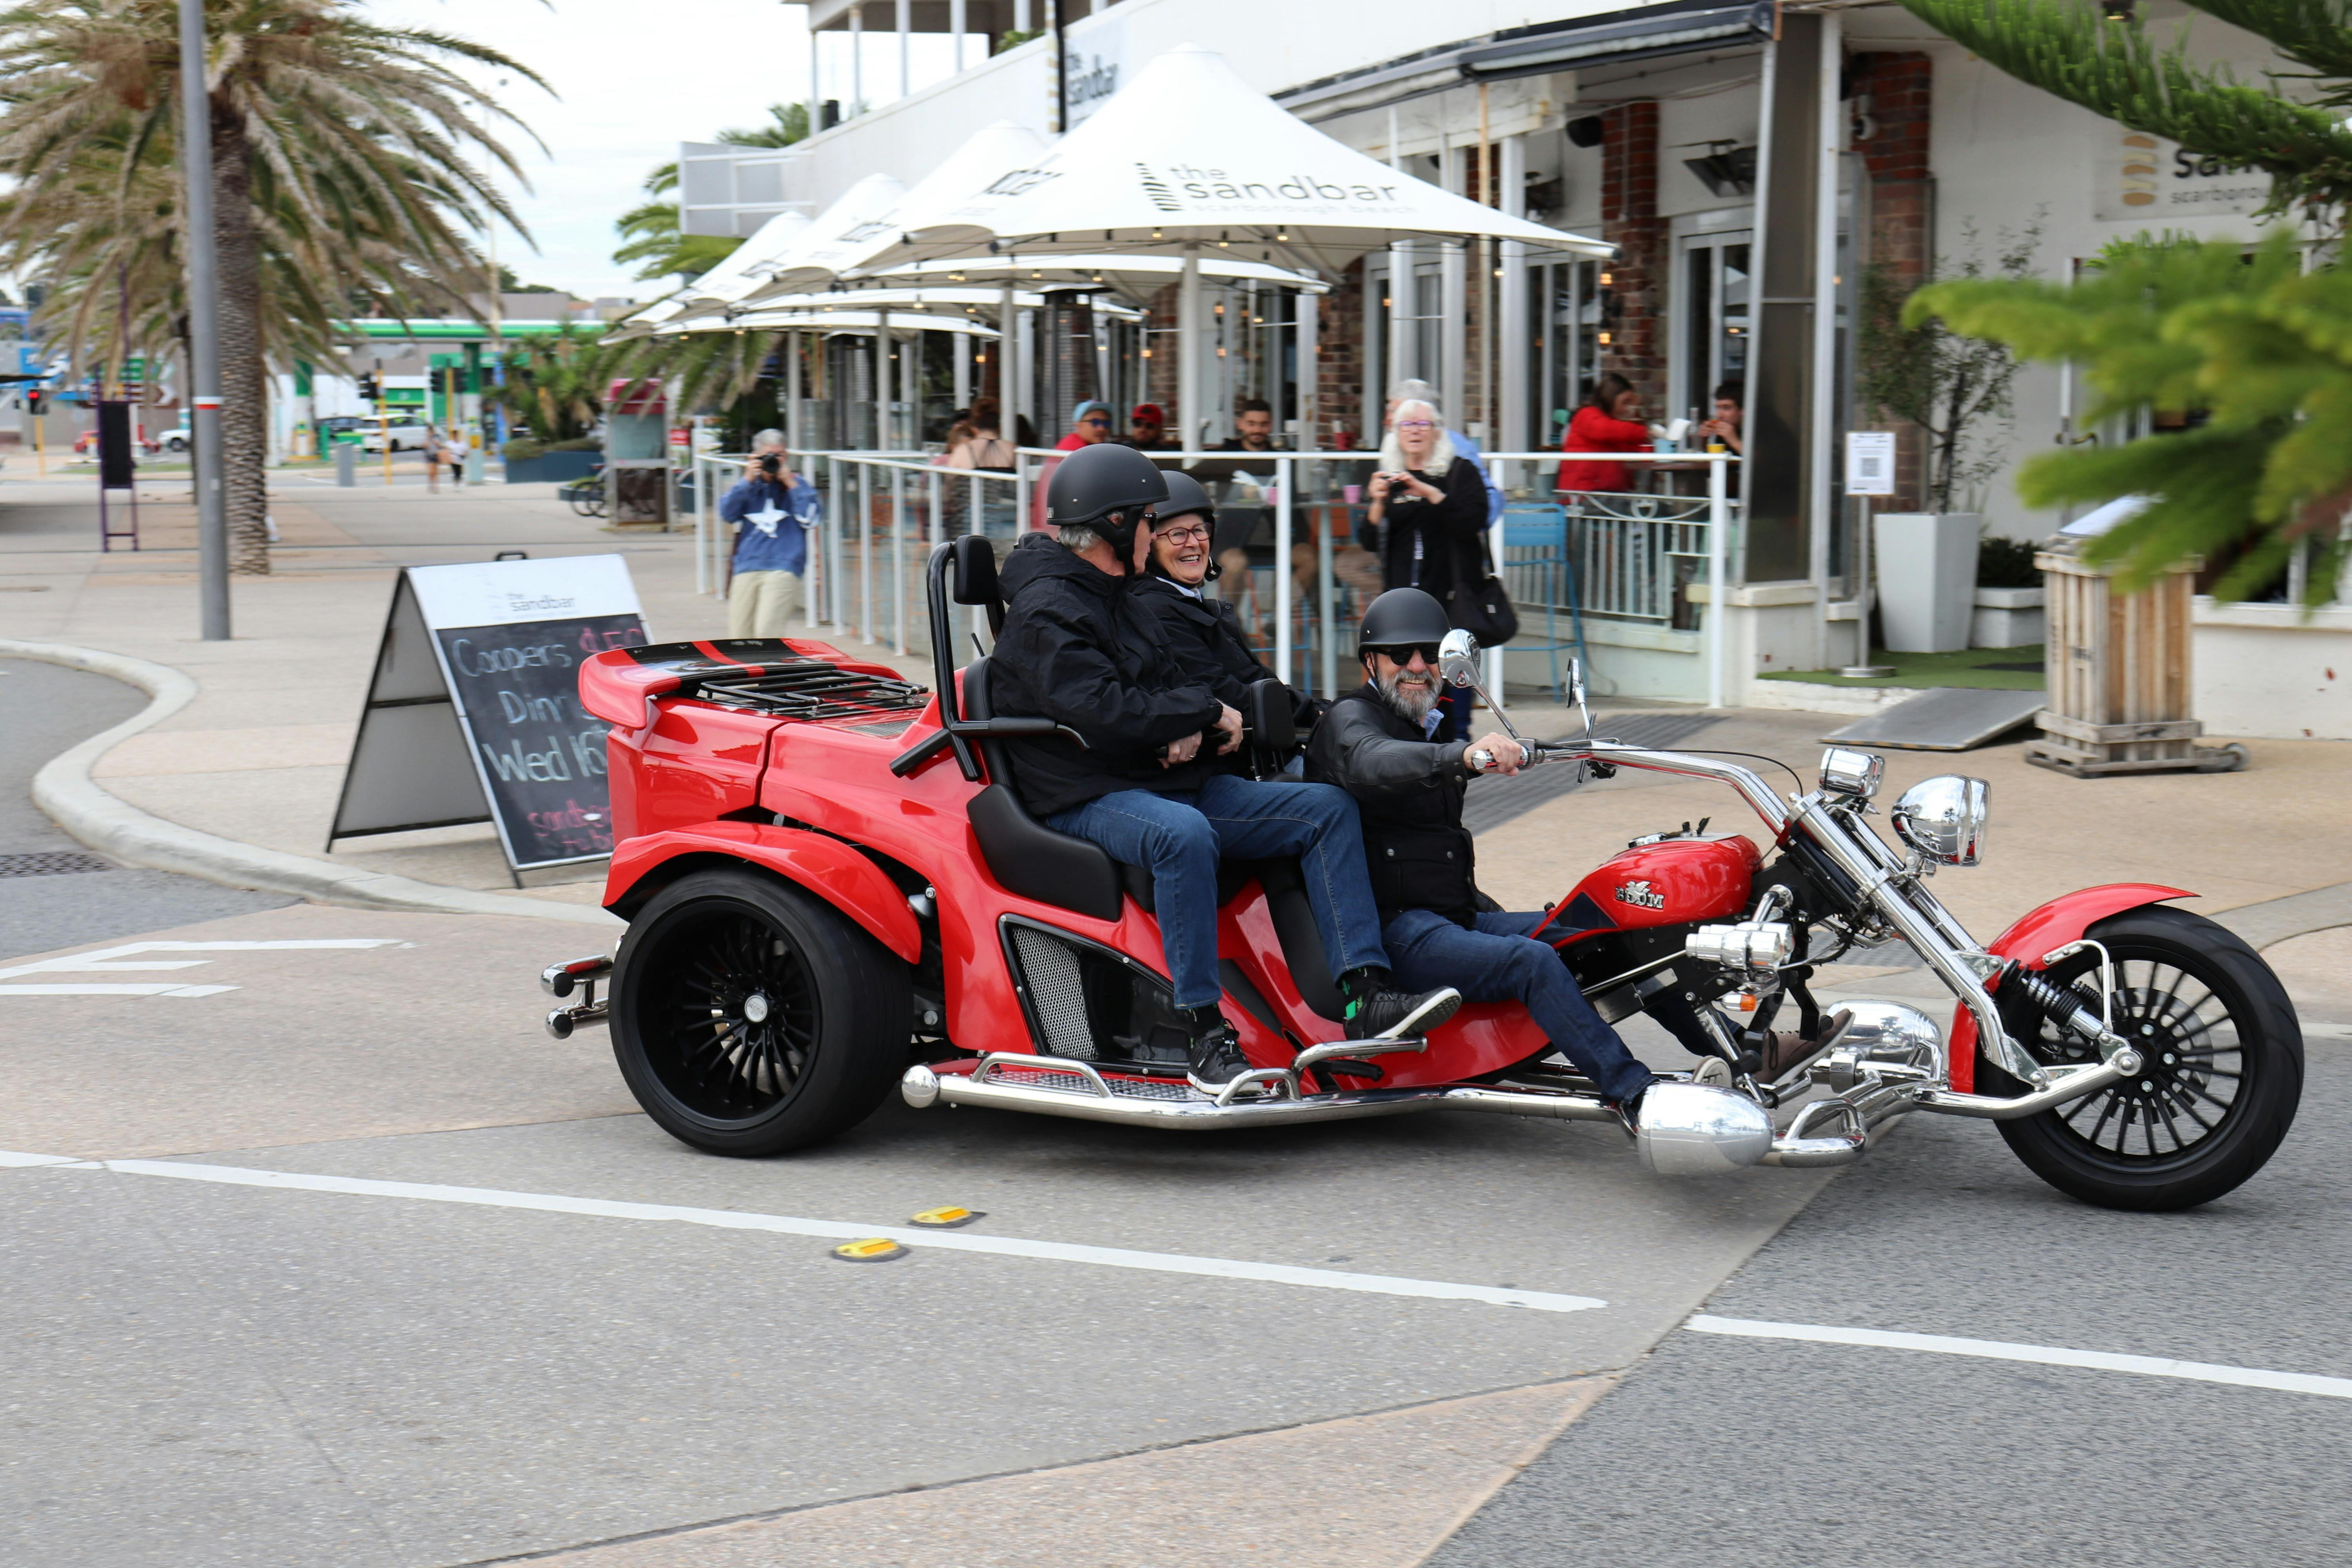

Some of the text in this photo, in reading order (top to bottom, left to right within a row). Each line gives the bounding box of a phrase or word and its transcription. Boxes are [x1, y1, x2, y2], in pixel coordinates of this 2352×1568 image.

[1169, 164, 1227, 180] the
[1184, 176, 1396, 200] sandbar
[510, 594, 575, 612] sandbar
[452, 639, 572, 681] Coopers
[482, 736, 573, 782] Wed
[1615, 886, 1664, 909] BOOM
